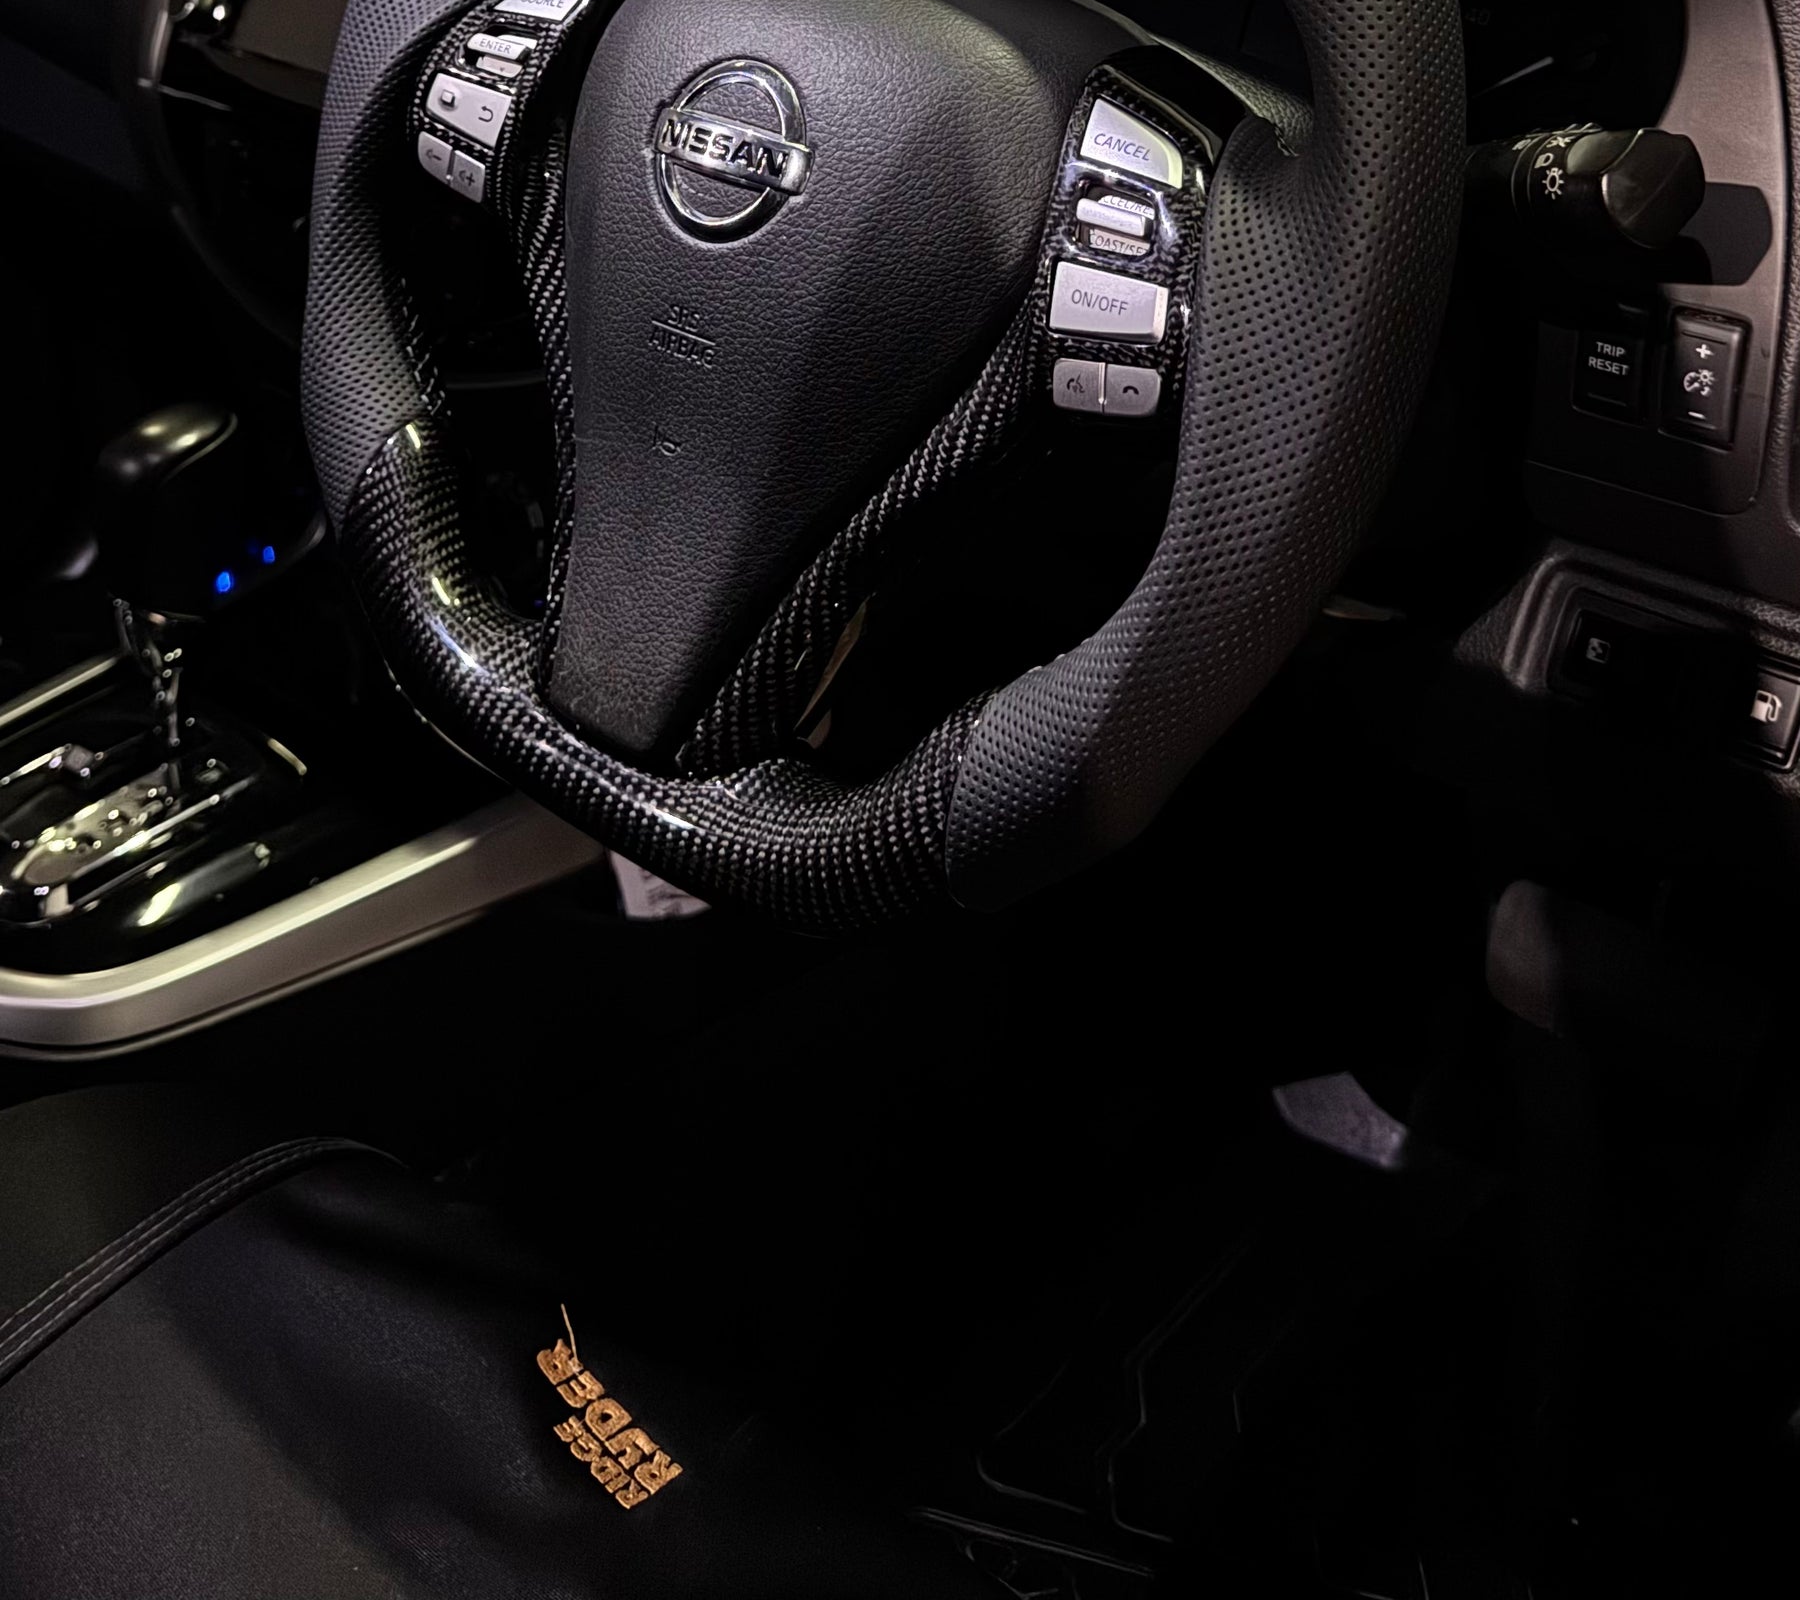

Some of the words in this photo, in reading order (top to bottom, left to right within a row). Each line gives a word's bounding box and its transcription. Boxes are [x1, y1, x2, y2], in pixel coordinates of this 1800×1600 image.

[478, 36, 513, 55] ENTER
[660, 117, 788, 179] NISSAN
[1093, 132, 1152, 163] CANCEL
[1071, 288, 1129, 317] ON/OFF
[1595, 341, 1627, 358] TRIP
[1587, 355, 1631, 377] RESET
